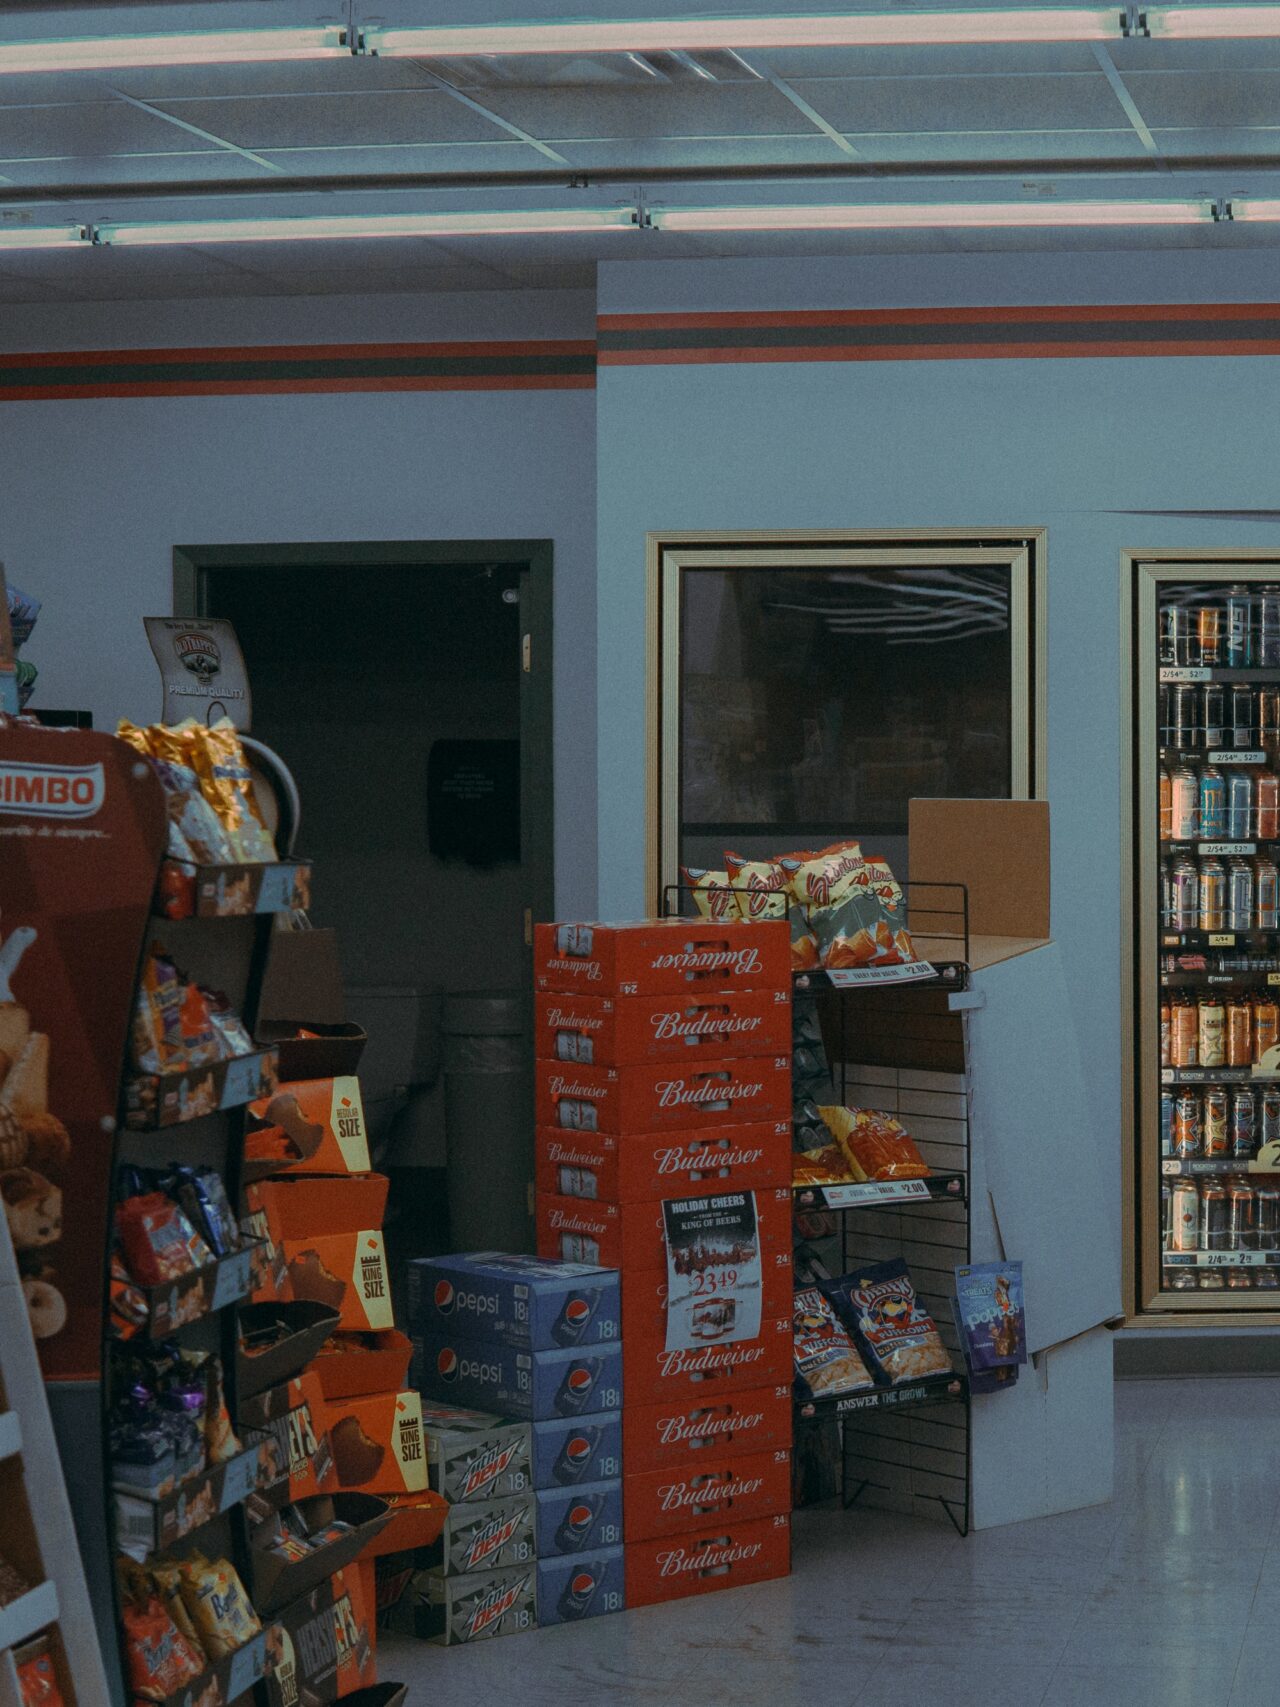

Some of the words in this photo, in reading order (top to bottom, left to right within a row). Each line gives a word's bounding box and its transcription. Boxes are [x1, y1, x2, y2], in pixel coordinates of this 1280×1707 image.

[169, 684, 209, 697] PREMIUM
[209, 687, 245, 699] QUALITY
[0, 774, 95, 805] IMBO
[651, 948, 762, 975] Budweiser
[774, 992, 786, 1001] 24
[547, 1008, 603, 1030] Budweiser
[650, 1012, 761, 1039] Budweiser
[774, 1058, 786, 1067] 24
[548, 1076, 608, 1098] Budweiser
[655, 1080, 763, 1107] Budweiser
[338, 1117, 362, 1138] SIZE
[774, 1123, 786, 1133] 24
[547, 1142, 604, 1166] Budweiser
[653, 1147, 763, 1174] Budweiser
[775, 1189, 786, 1198] 24
[901, 1182, 925, 1193] $2.00
[671, 1198, 709, 1214] HOLIDAY
[711, 1194, 745, 1209] CHEERS
[548, 1208, 607, 1234] Budweiser
[681, 1220, 702, 1230] KING
[703, 1218, 714, 1227] OF
[715, 1215, 741, 1226] BEERS
[776, 1254, 788, 1265] 24
[362, 1265, 383, 1282] KING
[364, 1281, 385, 1299] SIZE
[456, 1290, 499, 1316] pepsi
[513, 1300, 526, 1321] 18
[597, 1320, 613, 1339] 18
[776, 1320, 788, 1331] 24
[656, 1345, 765, 1377] Budweiser
[459, 1359, 502, 1384] pepsi
[516, 1369, 529, 1390] 18
[600, 1389, 616, 1407] 18
[775, 1385, 787, 1396] 24
[837, 1394, 879, 1411] ANSWER
[881, 1390, 898, 1404] THE
[400, 1429, 420, 1445] KING
[656, 1411, 764, 1444] Budweiser
[401, 1444, 422, 1462] SIZE
[774, 1450, 785, 1461] 24
[599, 1456, 615, 1477] 18
[508, 1472, 525, 1490] 18
[657, 1477, 764, 1511] Budweiser
[773, 1514, 785, 1526] 24
[600, 1525, 616, 1543] 18
[513, 1541, 528, 1560] 18
[656, 1541, 762, 1577] Budweiser
[603, 1592, 618, 1611] 18
[513, 1609, 529, 1628] 18
